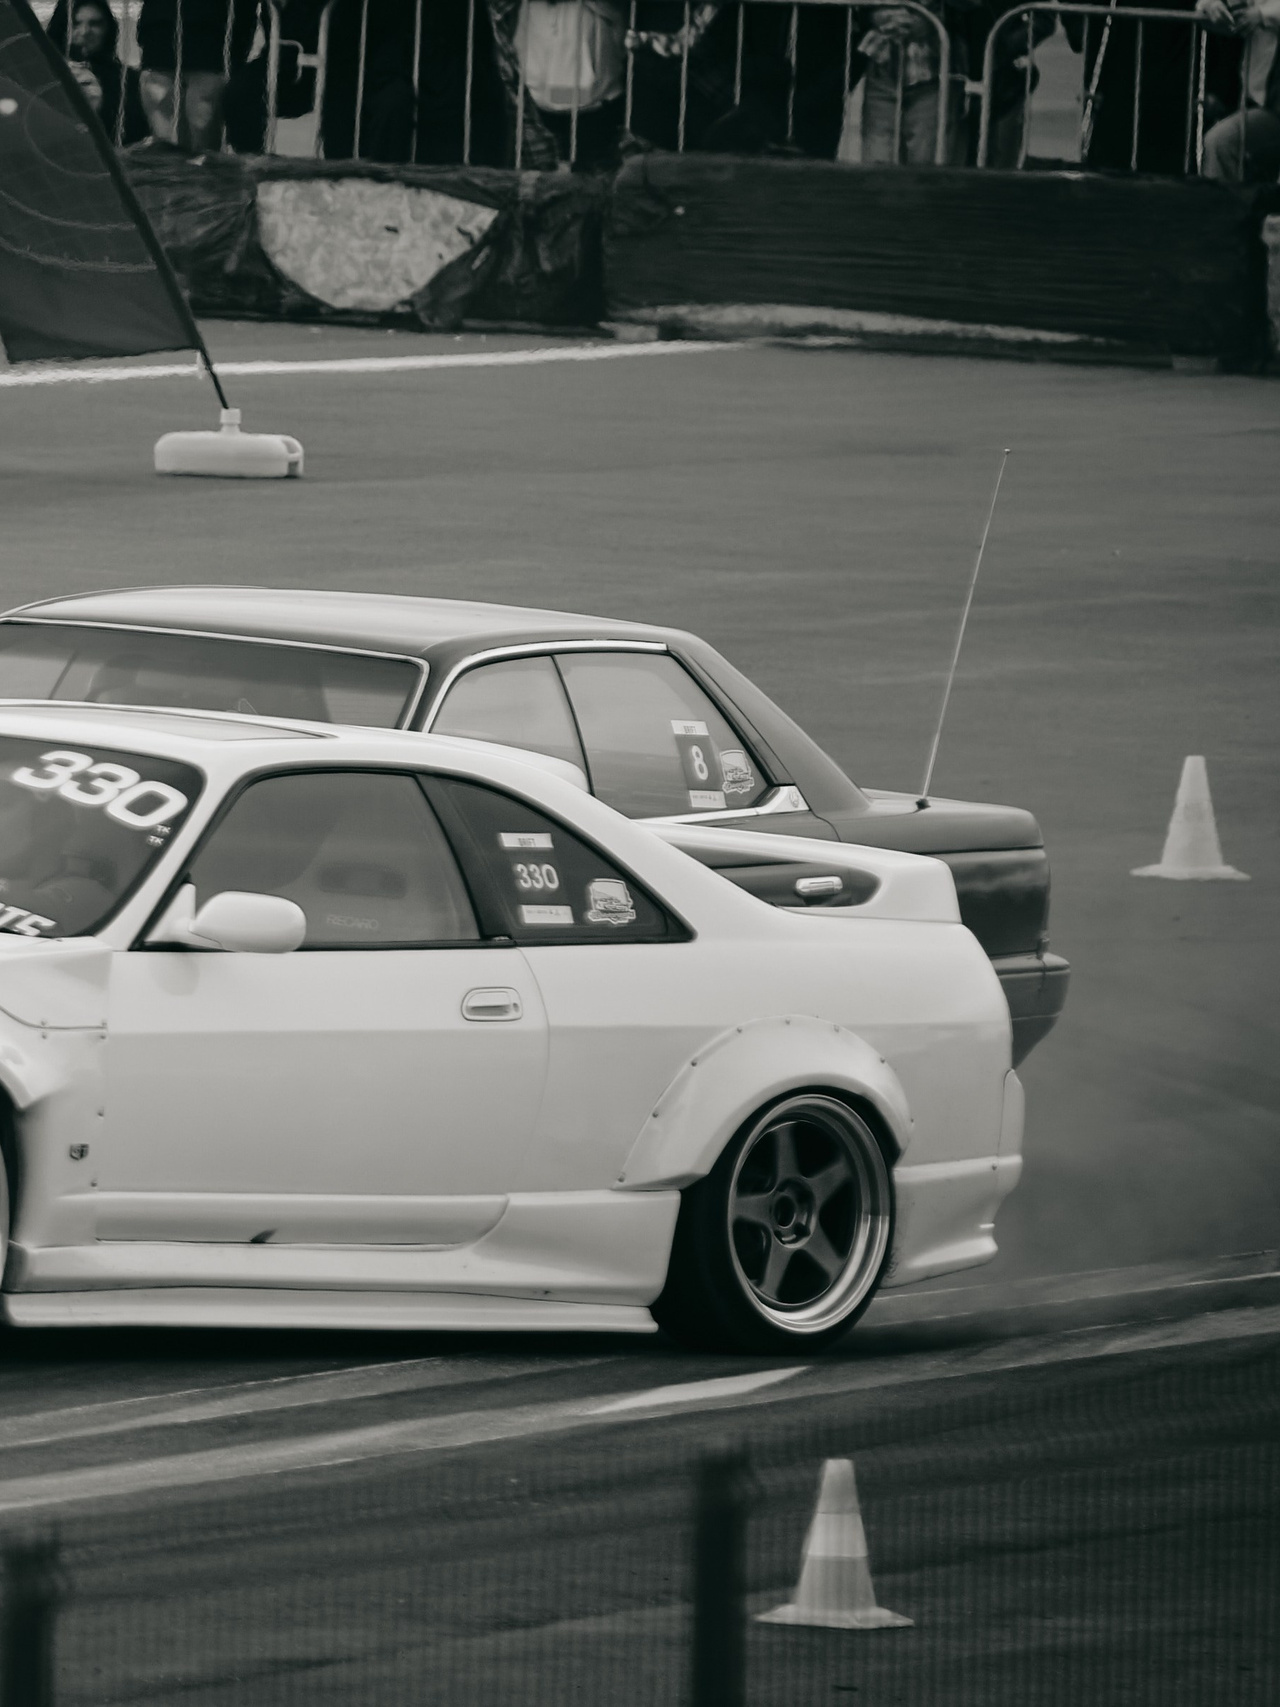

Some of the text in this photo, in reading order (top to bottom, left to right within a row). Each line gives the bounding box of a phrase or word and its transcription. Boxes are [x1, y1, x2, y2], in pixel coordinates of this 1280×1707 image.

[691, 744, 709, 780] 8
[11, 750, 188, 827] 330
[516, 863, 560, 889] 330
